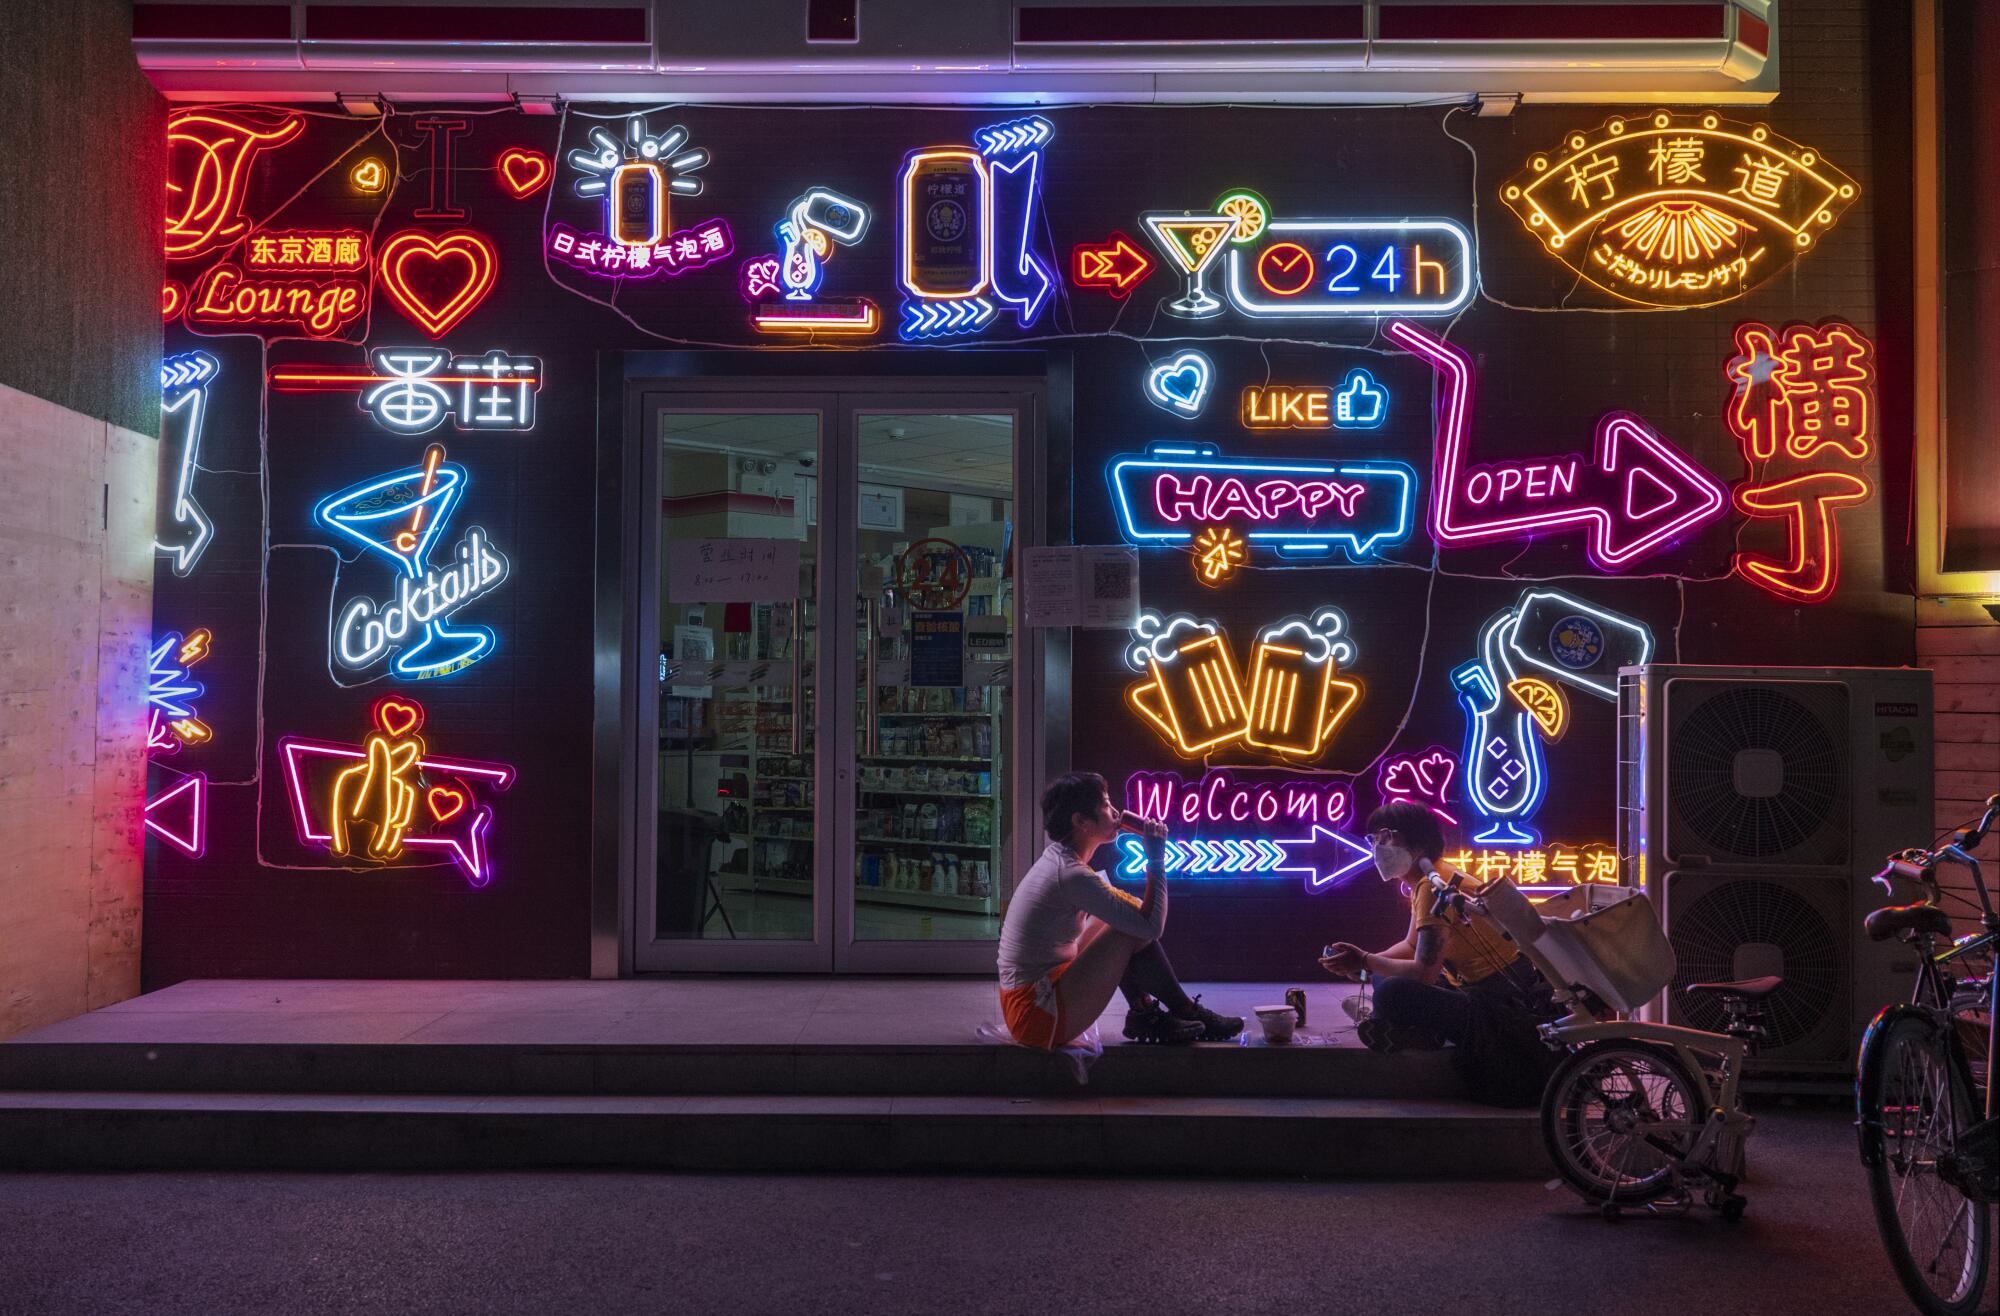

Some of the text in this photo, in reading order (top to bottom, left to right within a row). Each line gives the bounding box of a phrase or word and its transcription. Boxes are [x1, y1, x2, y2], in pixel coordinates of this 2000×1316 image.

[1564, 136, 1790, 209] 柠檬道
[250, 236, 361, 266] 东京酒廊
[553, 227, 725, 270] 日式柠檬气泡酒
[1326, 244, 1445, 295] 24h
[1593, 243, 1767, 291] こだわりレモンサワー
[196, 270, 357, 330] Lounge
[1250, 391, 1329, 422] LIKE
[1466, 461, 1578, 506] OPEN
[1737, 330, 1869, 595] 横丁
[1155, 472, 1365, 522] HAPPY
[341, 532, 501, 663] Cocktails
[1876, 704, 1917, 716] HITACHI
[1135, 776, 1347, 824] Welcome
